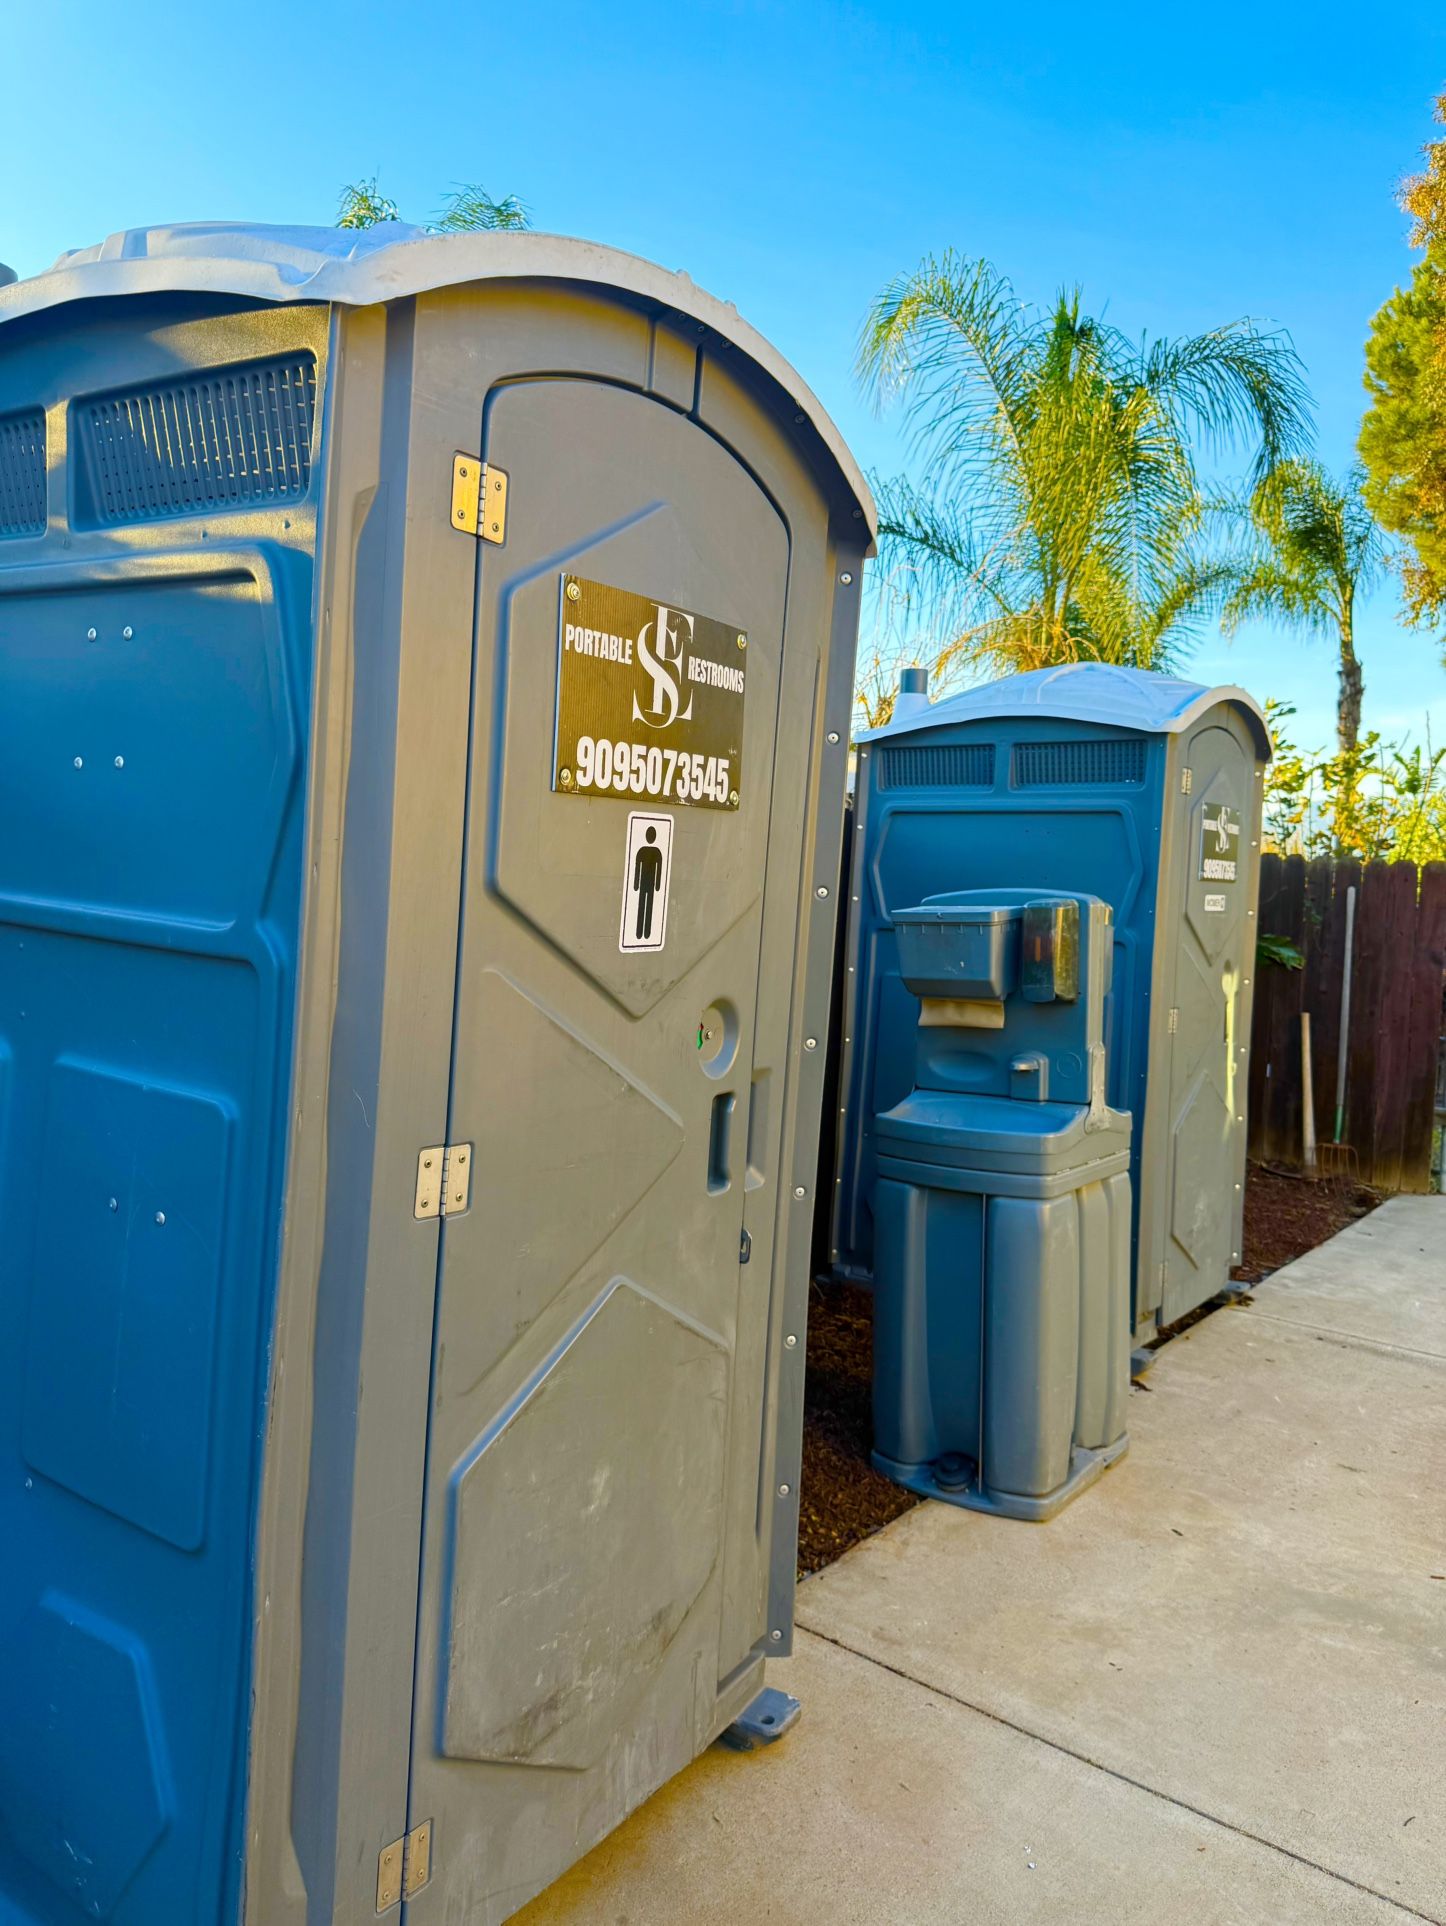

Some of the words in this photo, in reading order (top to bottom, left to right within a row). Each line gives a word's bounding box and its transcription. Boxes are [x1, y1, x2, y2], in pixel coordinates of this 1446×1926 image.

[565, 624, 633, 665] PORTABLE
[687, 656, 745, 694] RESTROOMS
[576, 735, 730, 804] 9095073545
